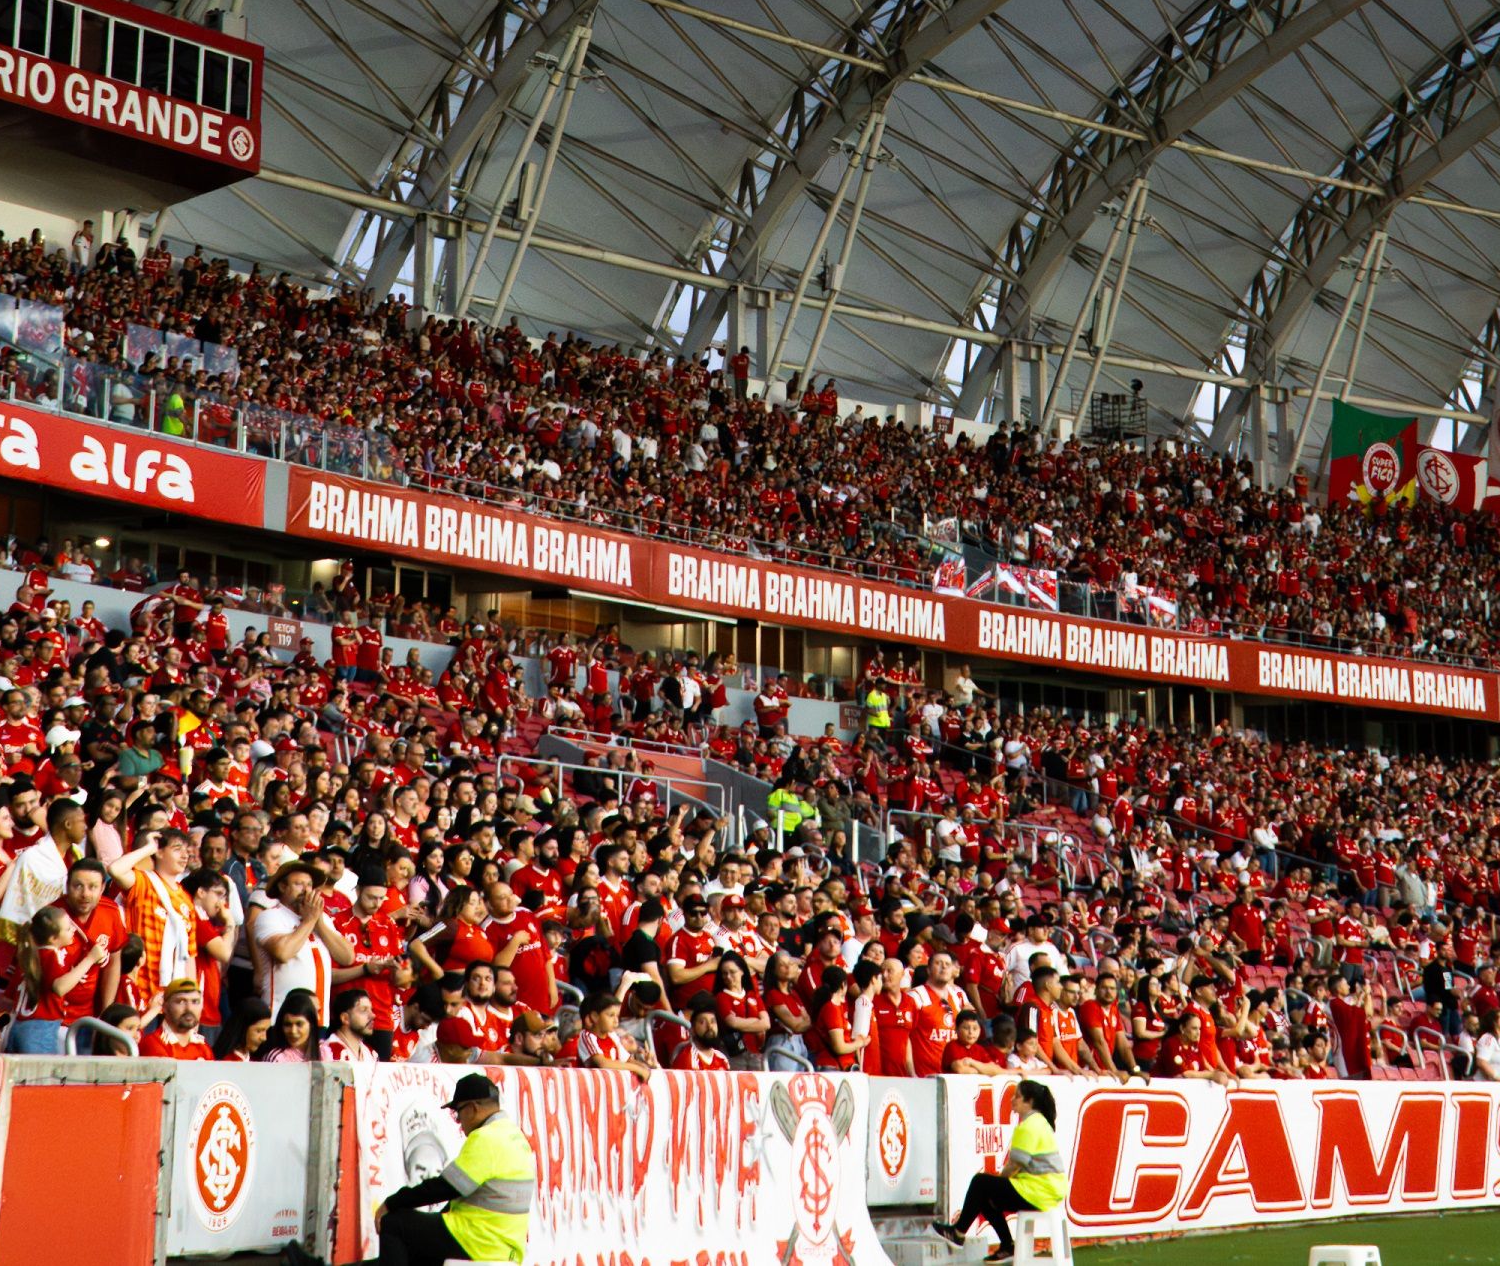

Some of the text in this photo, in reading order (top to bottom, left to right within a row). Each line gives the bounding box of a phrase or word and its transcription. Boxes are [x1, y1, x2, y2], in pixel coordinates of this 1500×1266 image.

[63, 73, 224, 155] GRANDE
[70, 435, 196, 503] alfa
[309, 481, 633, 588] BRAHMA BRAHMA BRAHMA
[667, 553, 946, 643] BRAHMA BRAHMA BRAHMA
[277, 633, 292, 647] 119
[978, 609, 1230, 683] BRAHMA BRAHMA BRAHMA
[1258, 650, 1486, 713] BRAHMA BRAHMA BRAHMA
[389, 1065, 451, 1104] INDEPEN
[485, 1066, 655, 1202] ABINHO
